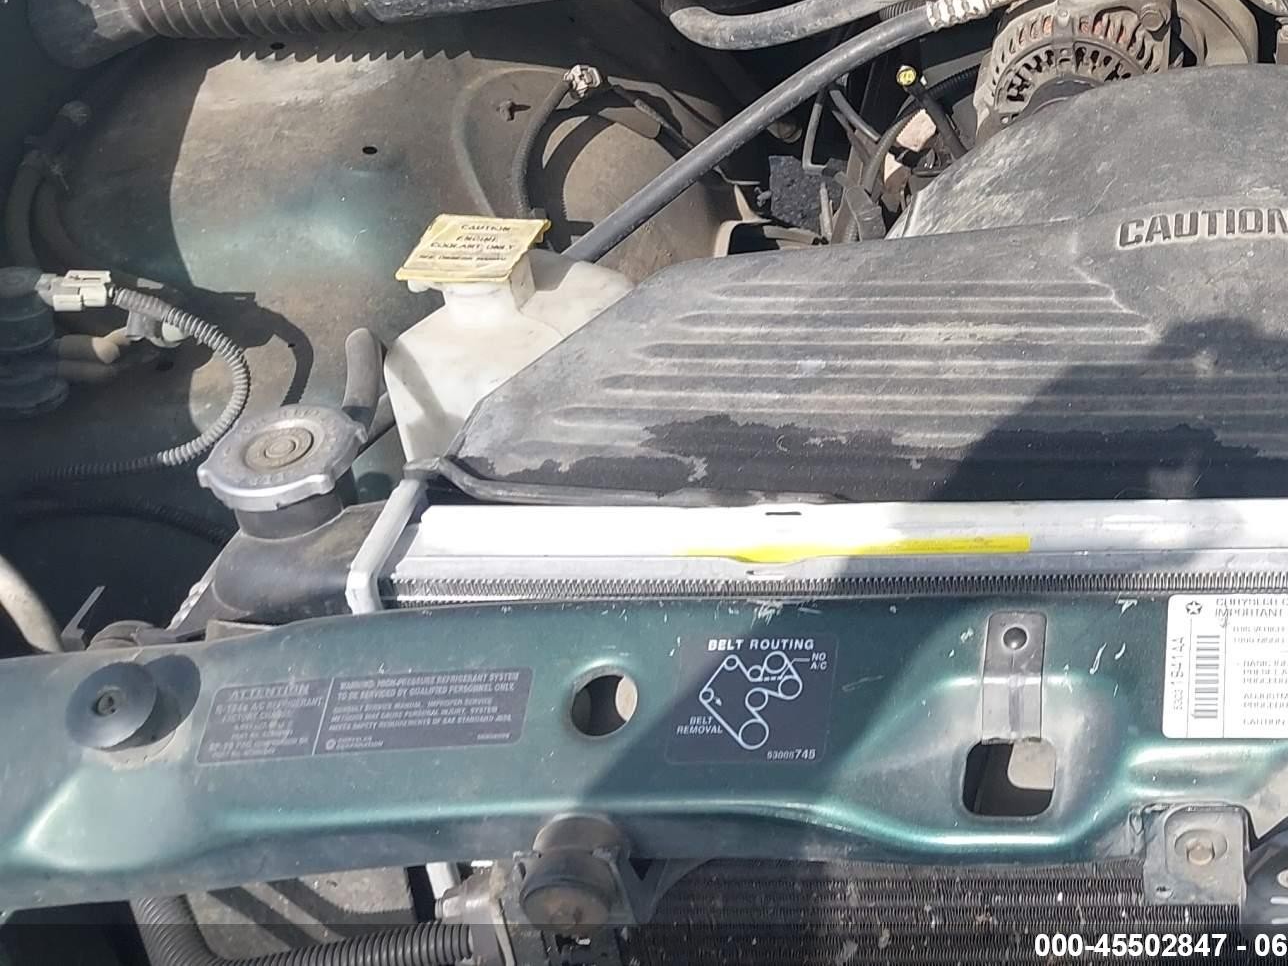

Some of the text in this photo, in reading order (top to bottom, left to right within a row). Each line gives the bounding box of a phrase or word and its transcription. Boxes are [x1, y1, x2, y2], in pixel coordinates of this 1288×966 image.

[707, 638, 815, 652] BELT ROUTING
[811, 652, 827, 662] NO
[810, 661, 828, 671] A/C
[436, 673, 487, 687] REFRIGERANT
[488, 671, 519, 683] SYSTEM
[229, 683, 310, 701] ATTENTION
[337, 692, 348, 701] TO
[348, 691, 359, 700] BE
[360, 688, 396, 700] SERVICED
[397, 687, 408, 698] BY
[409, 685, 448, 697] QUALIFIED
[448, 682, 493, 695] PERSONNEL
[689, 716, 714, 725] BELT
[676, 725, 723, 735] REMOVAL
